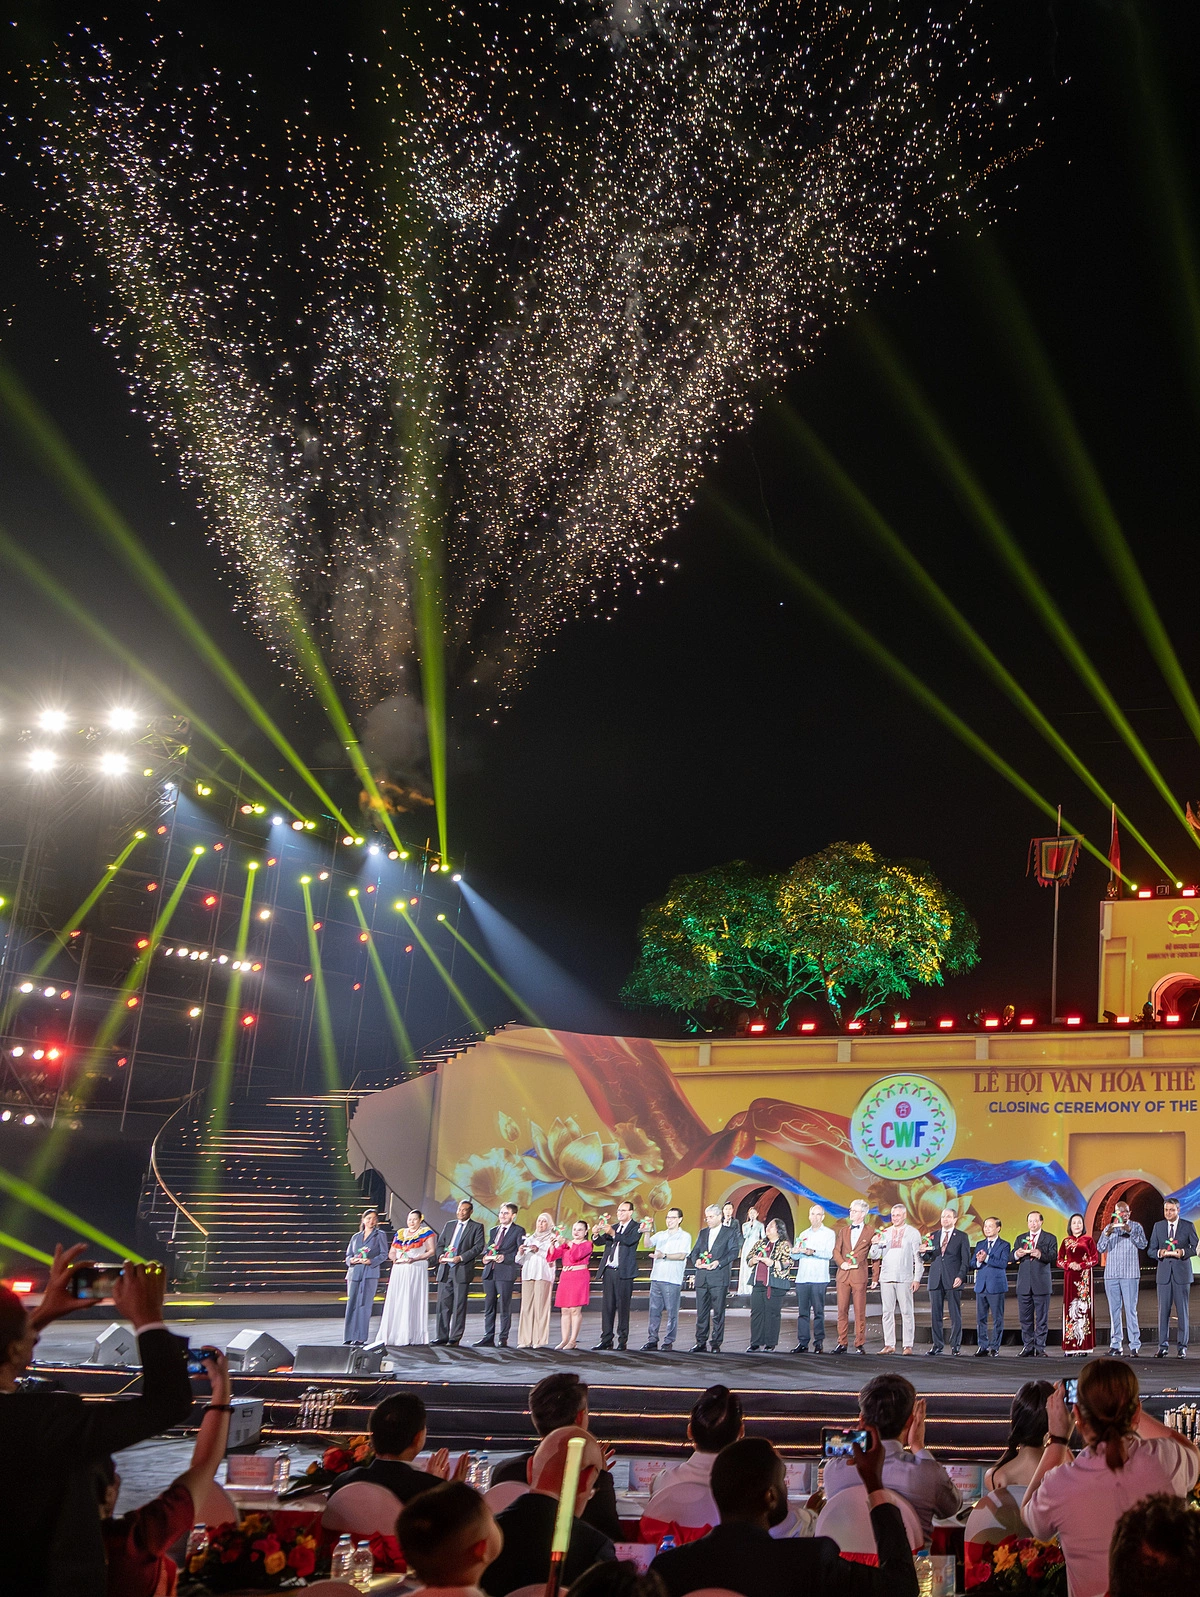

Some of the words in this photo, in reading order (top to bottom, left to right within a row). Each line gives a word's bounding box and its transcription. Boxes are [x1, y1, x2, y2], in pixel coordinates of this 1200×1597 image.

[1005, 1069, 1043, 1095] HỘI
[1100, 1067, 1146, 1093] HÓA
[989, 1101, 1050, 1113] CLOSING
[1054, 1100, 1141, 1113] CEREMONY
[1145, 1100, 1165, 1112] OF
[1169, 1099, 1198, 1112] THE
[881, 1121, 928, 1148] CWF
